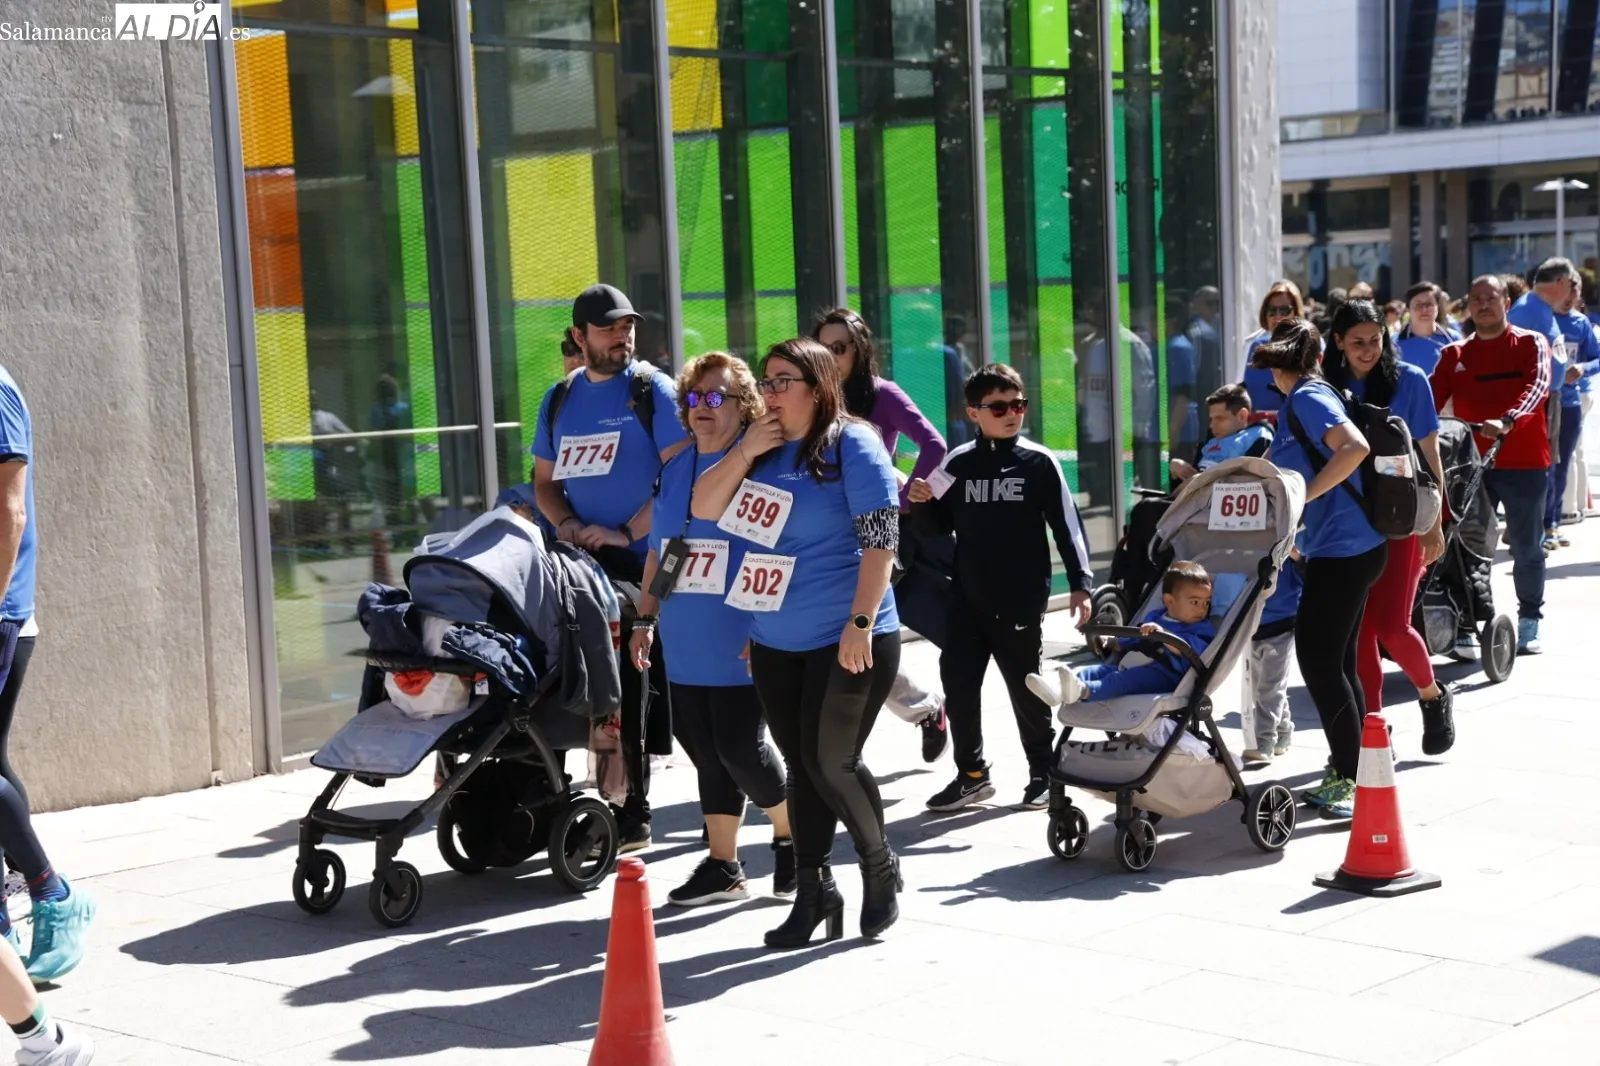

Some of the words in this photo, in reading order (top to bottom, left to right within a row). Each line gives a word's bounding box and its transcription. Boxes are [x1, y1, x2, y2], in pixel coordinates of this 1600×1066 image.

[561, 442, 615, 467] 1774
[965, 477, 1025, 503] NIKE
[736, 492, 781, 529] 599
[1221, 493, 1260, 517] 690
[685, 552, 717, 578] 77
